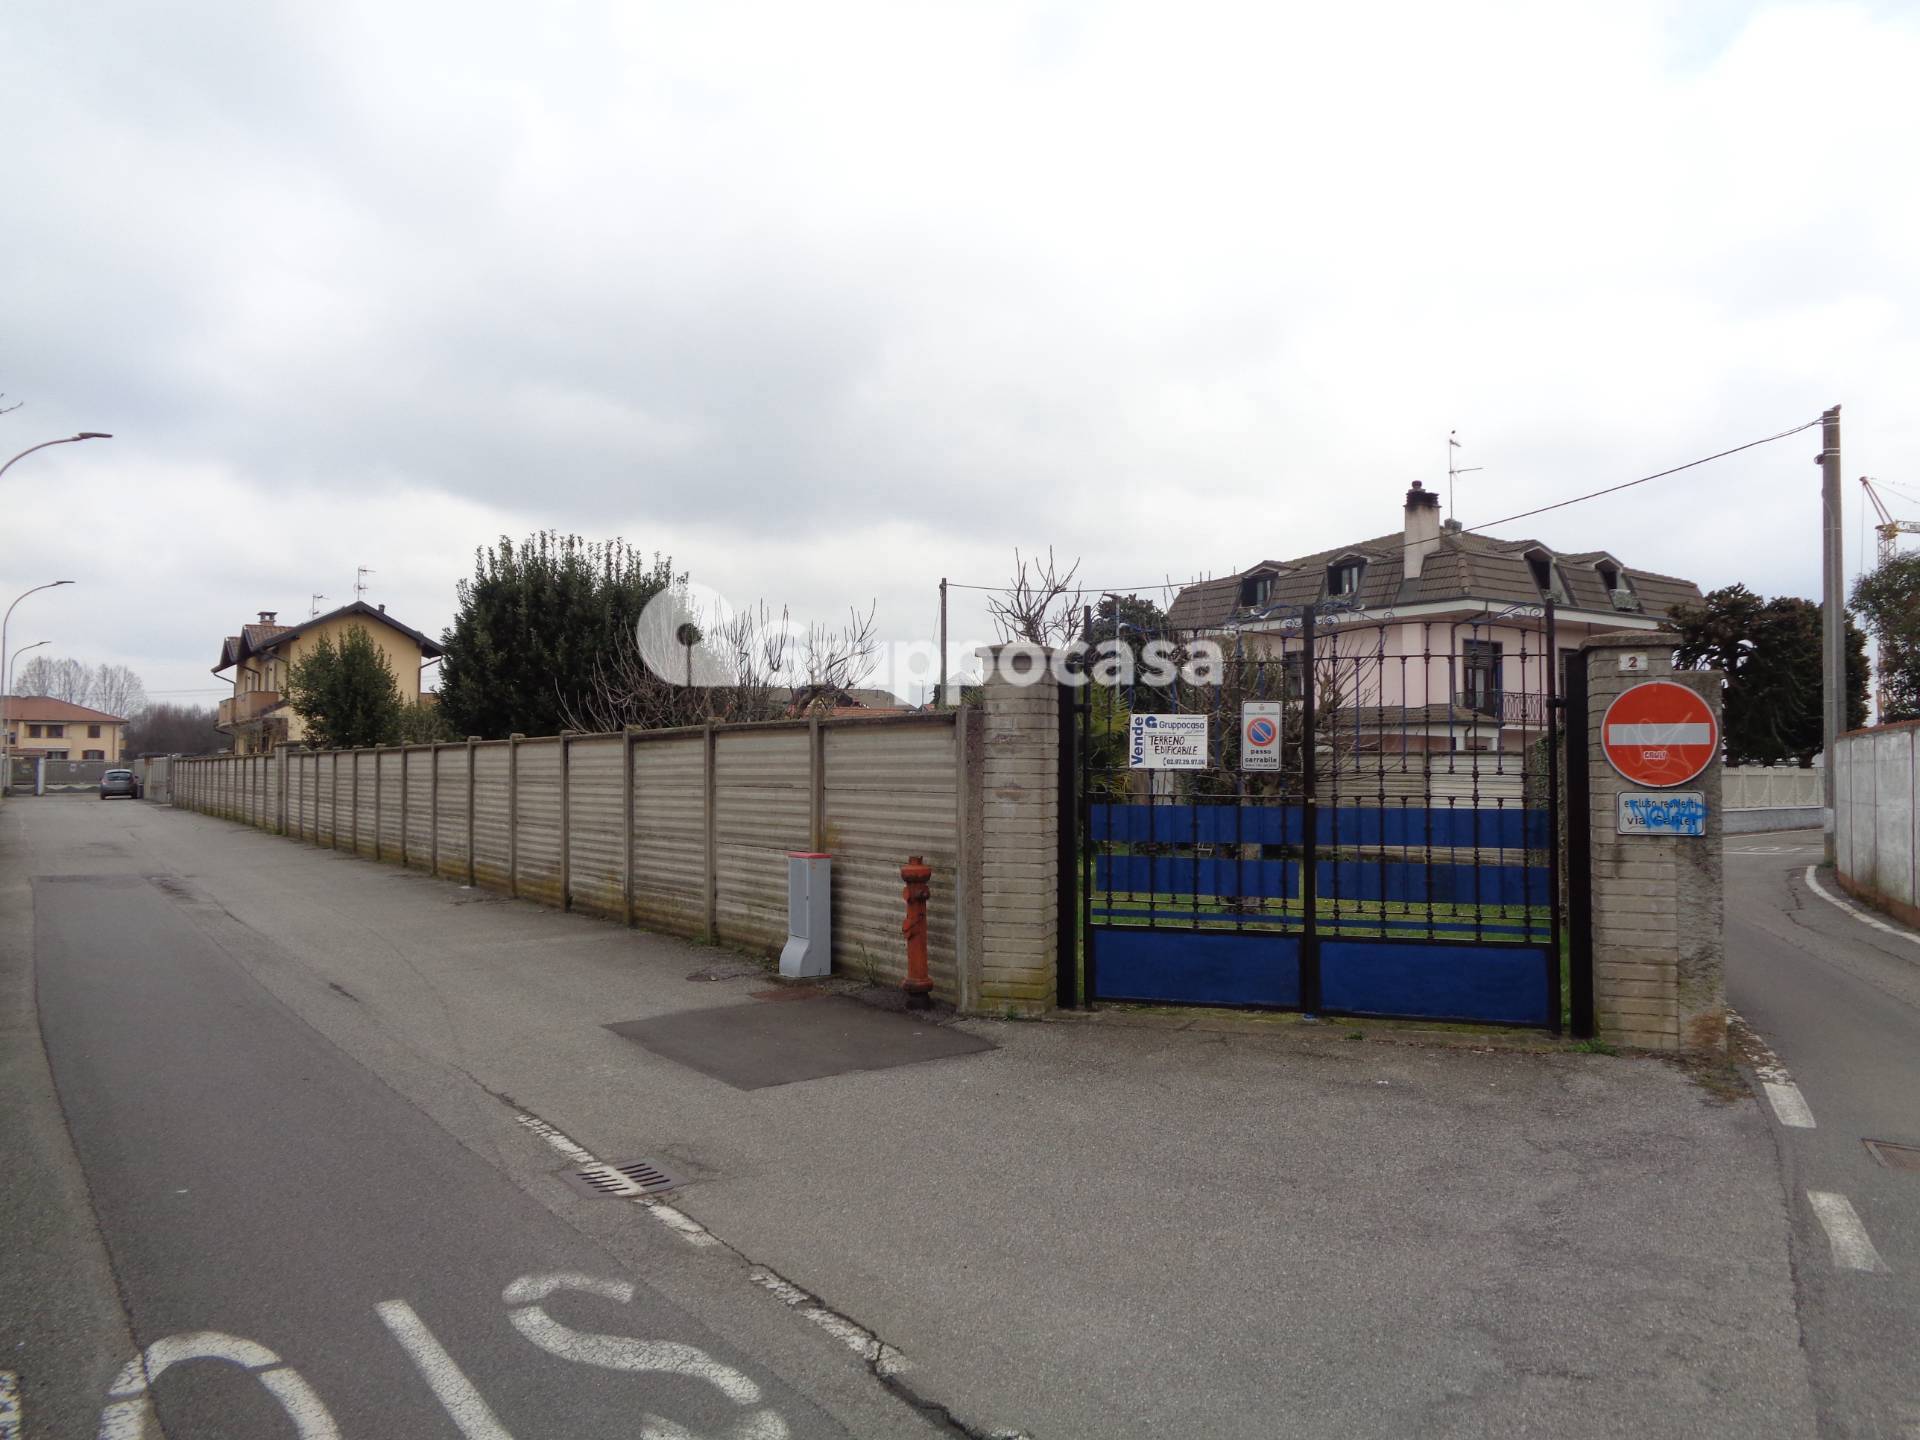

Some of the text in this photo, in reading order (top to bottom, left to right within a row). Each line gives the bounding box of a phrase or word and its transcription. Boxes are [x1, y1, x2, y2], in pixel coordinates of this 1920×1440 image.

[1629, 656, 1637, 667] 2
[1159, 721, 1205, 730] Gruppocasa
[1131, 717, 1143, 765] Vende
[1150, 736, 1185, 746] TERRENO
[1154, 746, 1198, 755] EDIFICABILE
[1627, 815, 1646, 825] via
